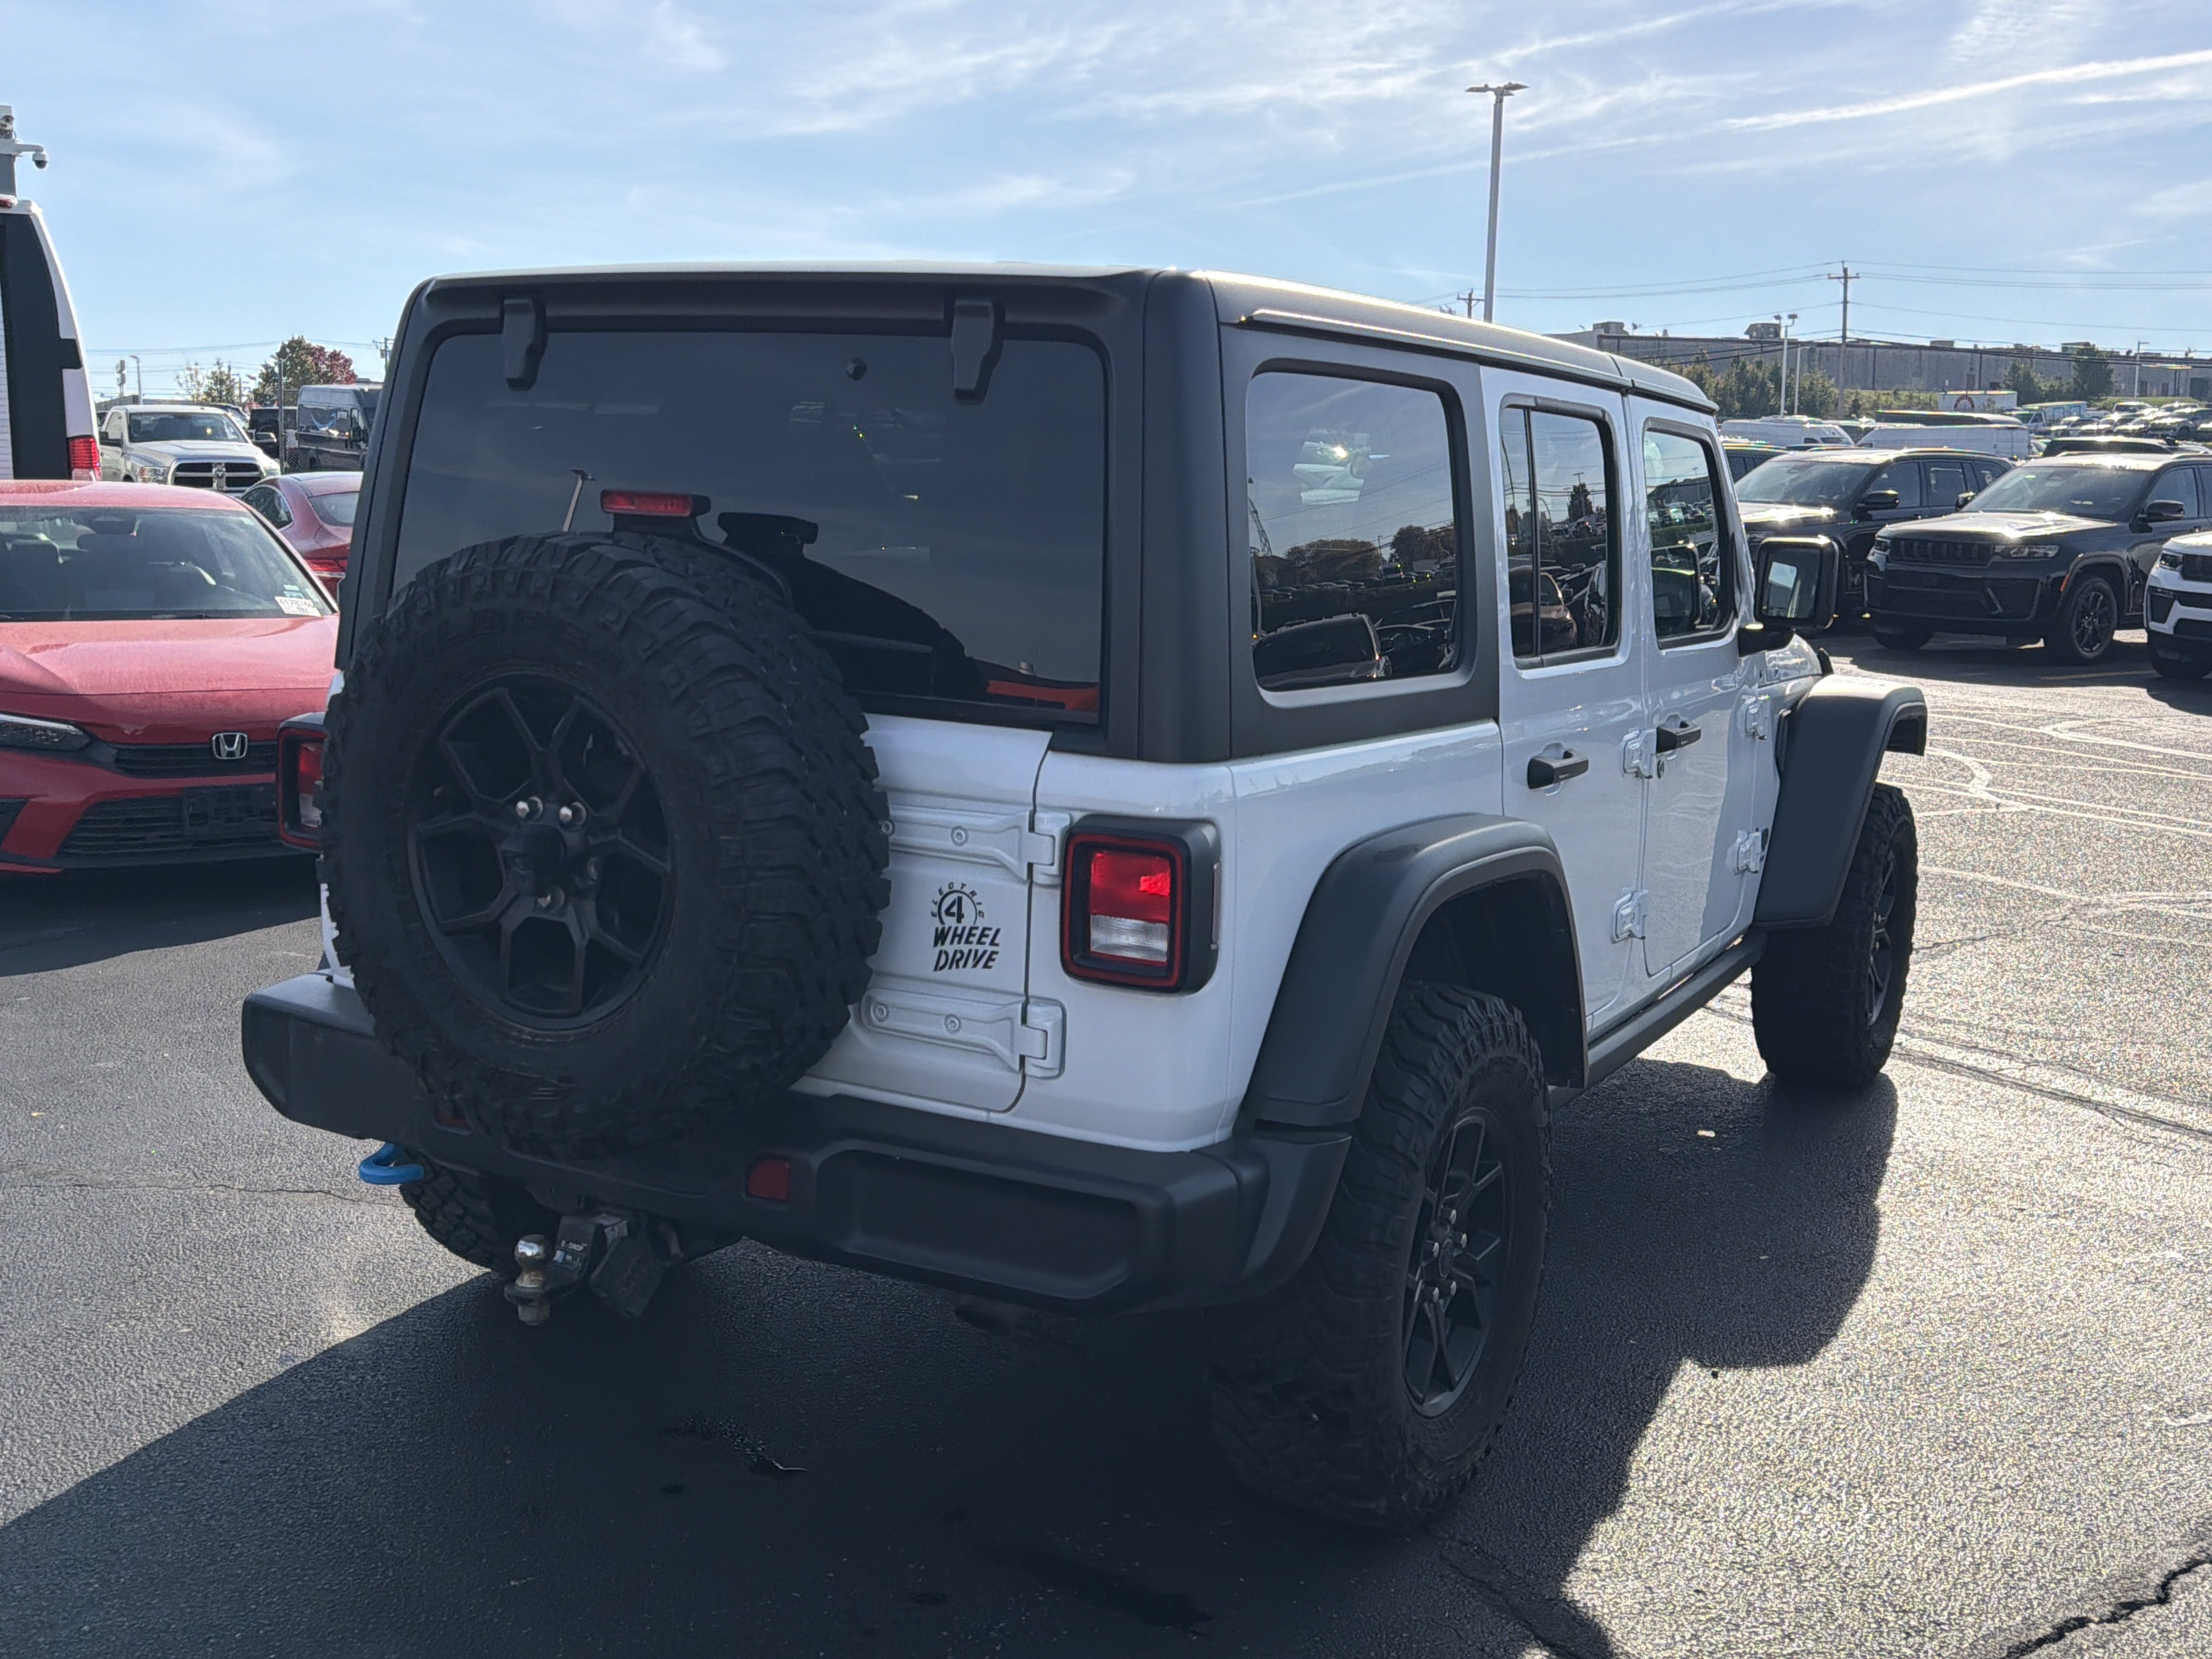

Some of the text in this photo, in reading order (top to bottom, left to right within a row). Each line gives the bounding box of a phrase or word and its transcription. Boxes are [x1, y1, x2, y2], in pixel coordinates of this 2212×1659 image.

[930, 882, 985, 918] ELECTRIC
[944, 895, 965, 924] 4
[933, 926, 1001, 948] WHEEL
[933, 949, 1000, 972] DRIVE
